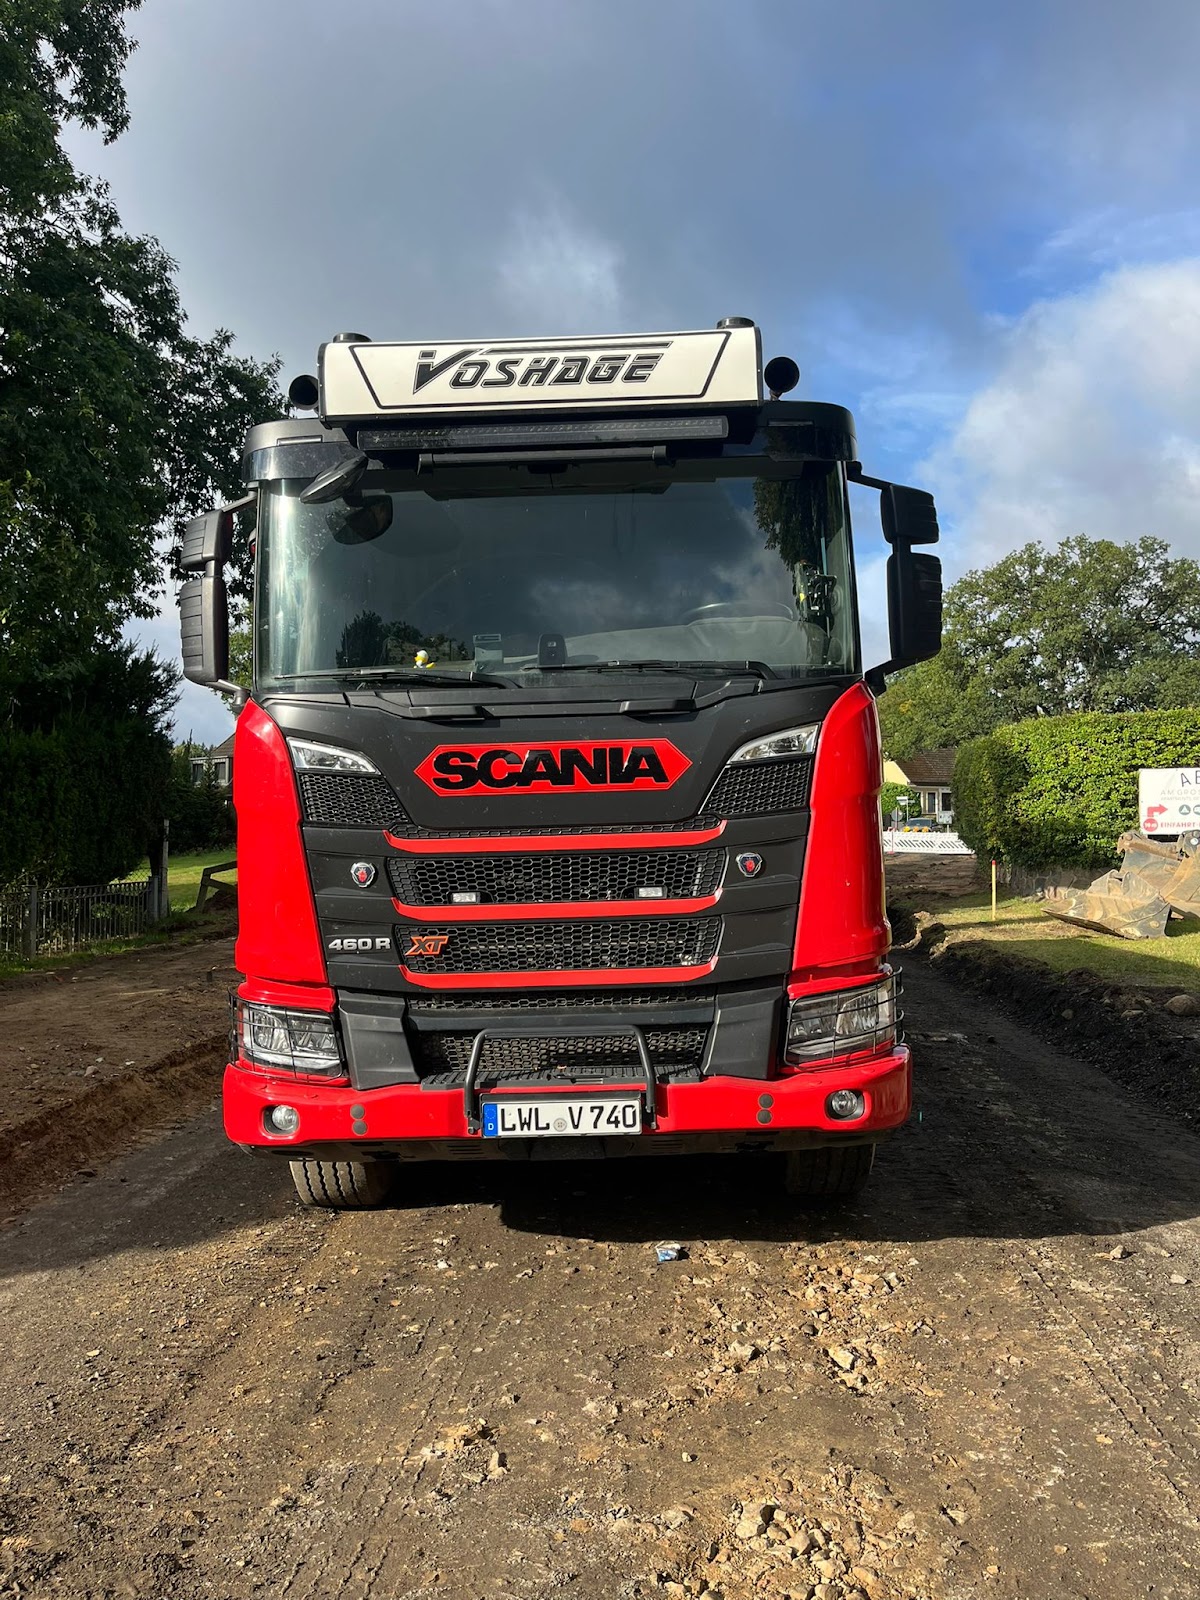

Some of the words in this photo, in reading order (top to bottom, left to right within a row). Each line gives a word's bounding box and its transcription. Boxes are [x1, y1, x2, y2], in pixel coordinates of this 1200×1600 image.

[412, 345, 667, 395] VOSHAGE
[432, 746, 670, 791] SCANIA
[328, 938, 373, 951] 460
[375, 937, 391, 950] R
[405, 935, 450, 956] XT
[487, 1122, 494, 1131] D
[501, 1107, 550, 1132] LWL
[568, 1106, 583, 1130] V
[590, 1104, 637, 1129] 740
